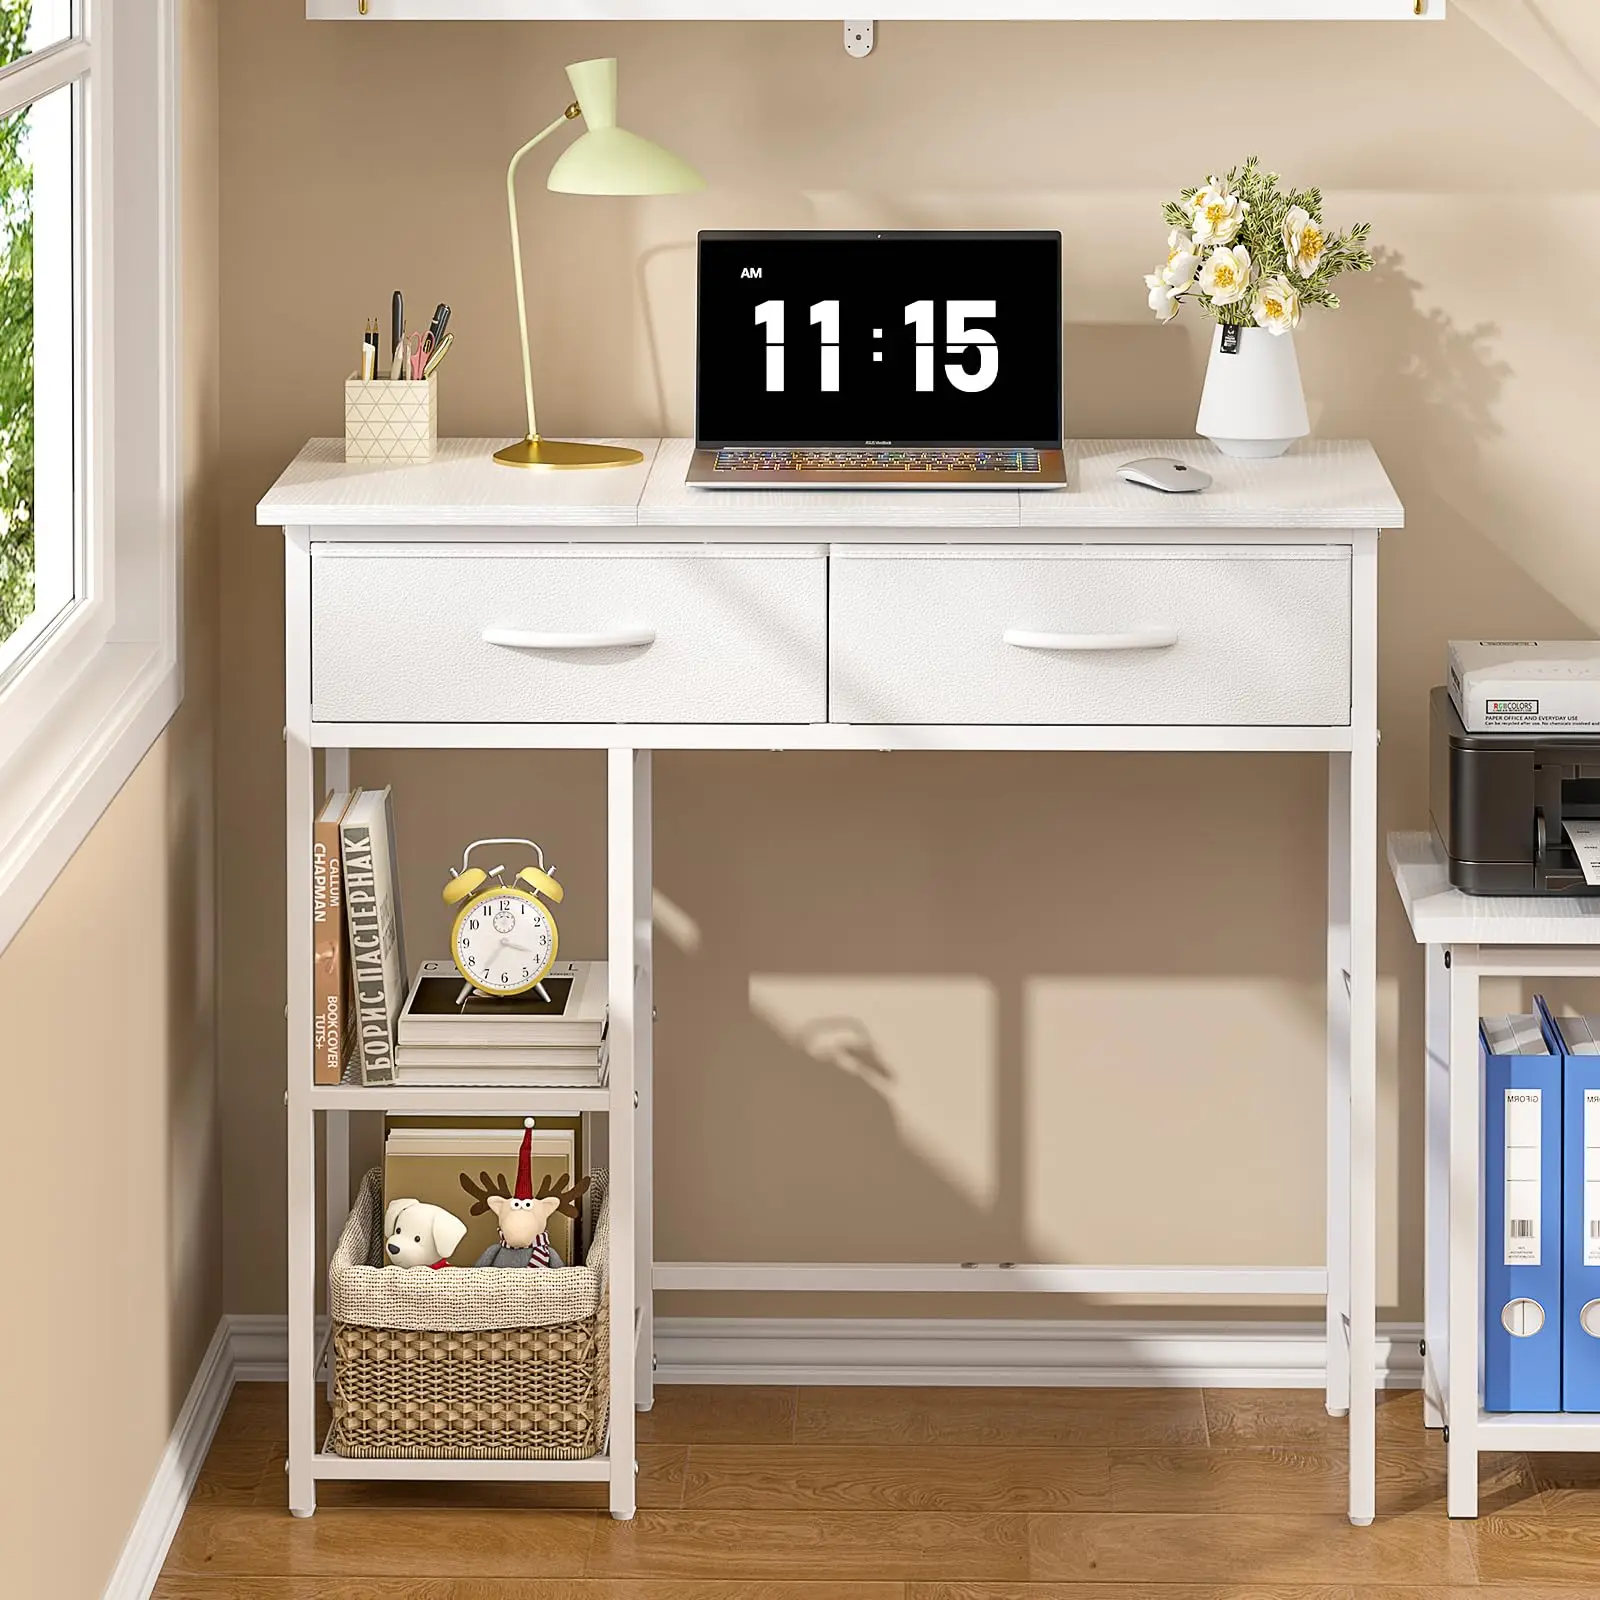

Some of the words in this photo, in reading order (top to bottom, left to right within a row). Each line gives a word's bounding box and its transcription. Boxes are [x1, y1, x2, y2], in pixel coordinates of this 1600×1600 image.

[740, 267, 763, 279] AM
[312, 842, 326, 923] CHAPMAN
[329, 857, 340, 908] CALLUM
[343, 834, 383, 984] ПАСТЕРНАК
[483, 905, 492, 916] 11
[499, 900, 510, 911] 12
[521, 904, 525, 915] 1
[469, 919, 480, 931] 10
[534, 917, 541, 928] 2
[462, 938, 470, 949] 9
[539, 935, 547, 946] 3
[468, 955, 476, 967] 8
[532, 953, 541, 964] 4
[483, 968, 490, 980] 7
[500, 972, 508, 984] 6
[522, 966, 529, 978] 5
[327, 995, 338, 1029] BOOK
[315, 1013, 326, 1050] TUTS+
[361, 989, 390, 1072] БОРИС
[327, 1029, 339, 1068] COVER
